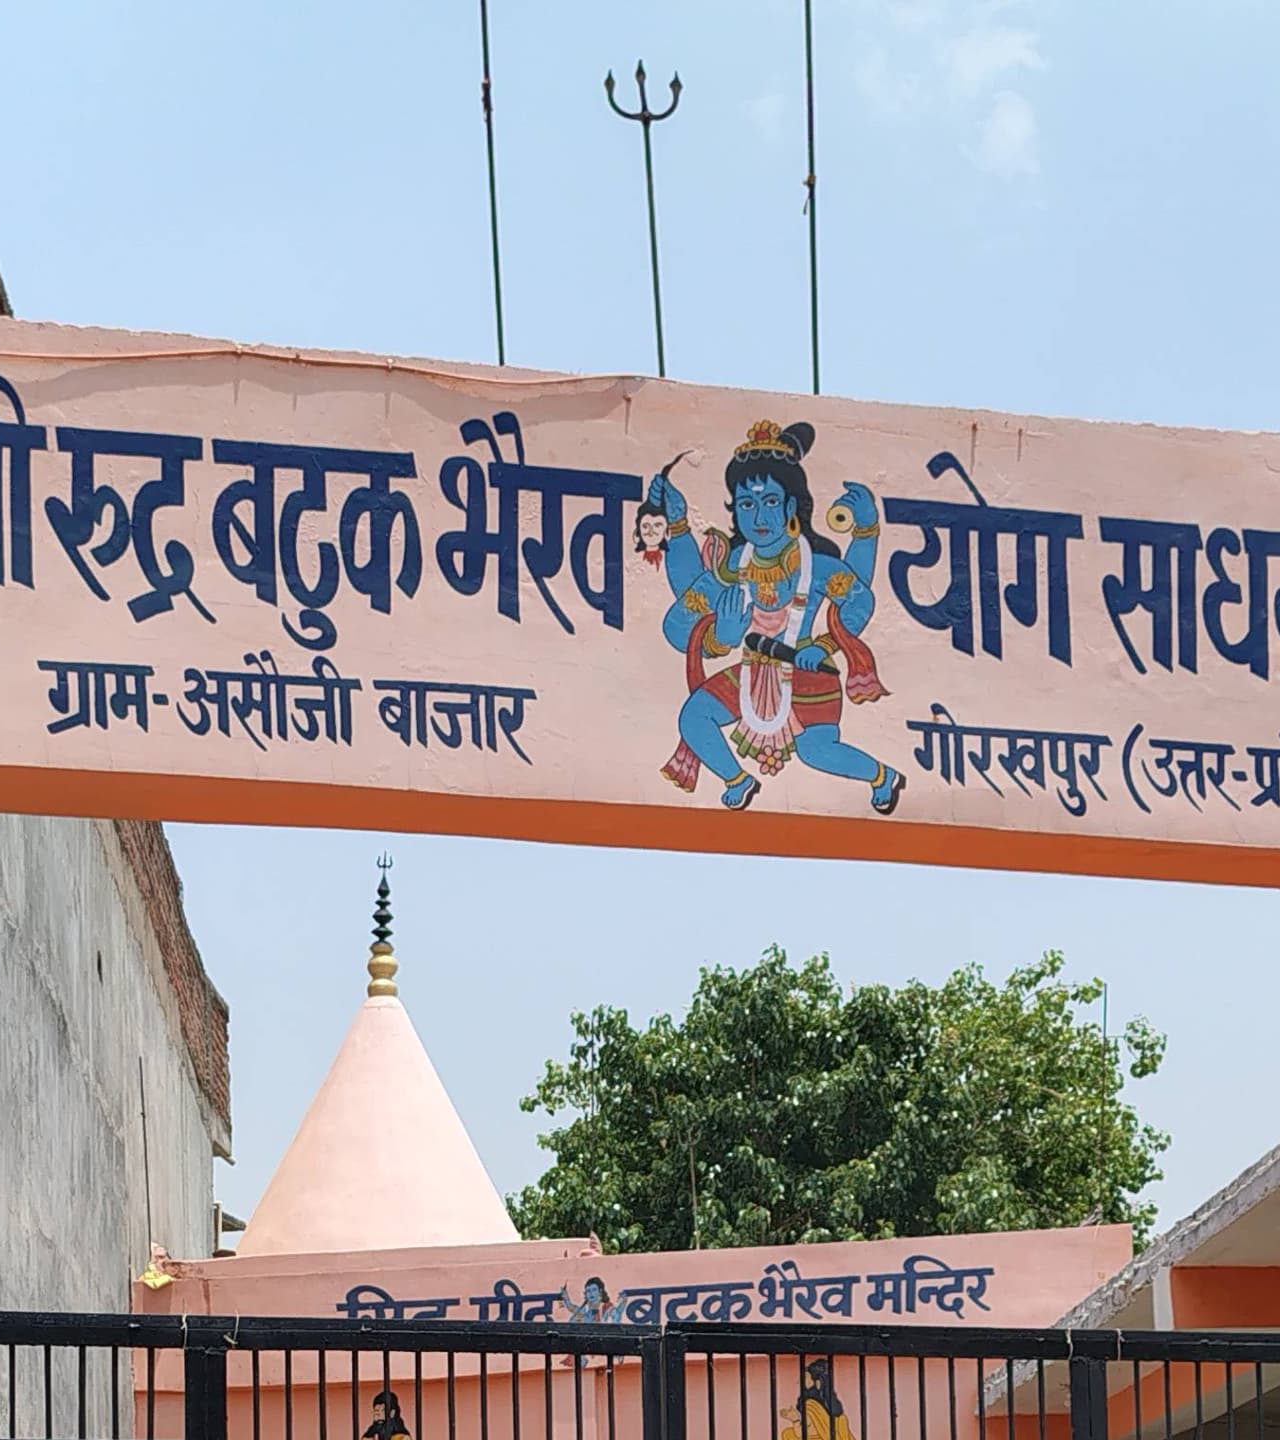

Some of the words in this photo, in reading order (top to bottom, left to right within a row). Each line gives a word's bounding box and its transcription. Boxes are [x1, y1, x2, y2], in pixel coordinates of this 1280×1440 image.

[44, 426, 216, 623] रुद्र
[212, 438, 423, 650] बटुक
[435, 411, 643, 634] भैरव
[882, 451, 1084, 666] योग
[373, 679, 536, 764] बाजार
[907, 702, 1112, 816] गोरखपुर
[758, 1258, 861, 1320] भैरव
[866, 1254, 994, 1320] मन्दिर
